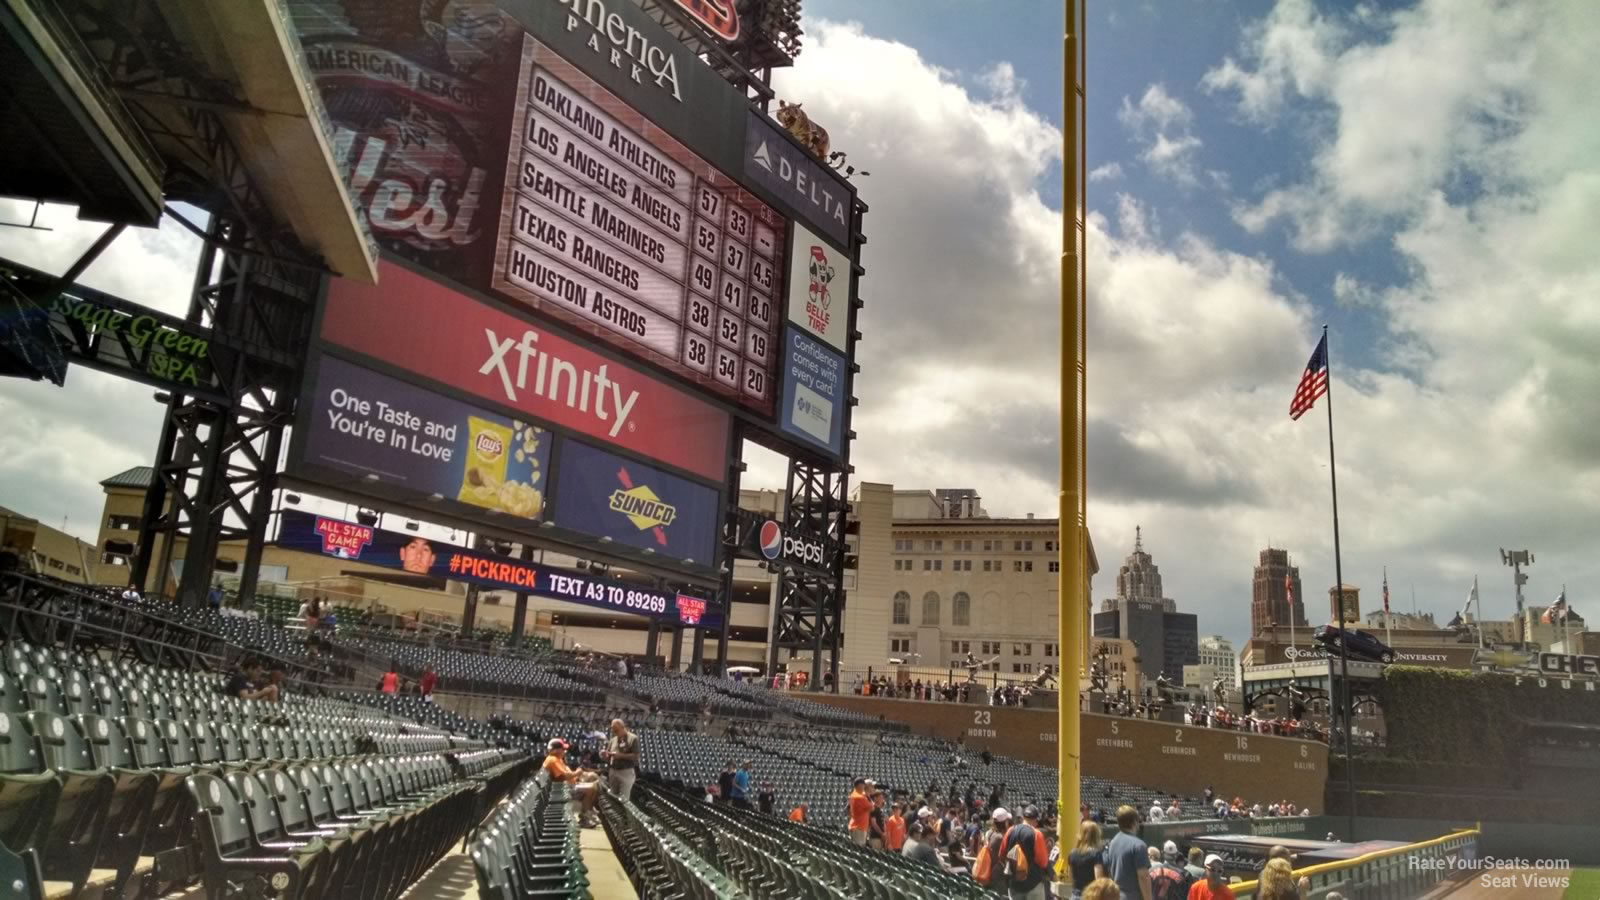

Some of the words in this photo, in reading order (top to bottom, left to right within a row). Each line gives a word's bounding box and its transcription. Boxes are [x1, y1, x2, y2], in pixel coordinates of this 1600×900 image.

[567, 14, 643, 84] PARK
[306, 50, 408, 82] AMERICAN
[418, 71, 487, 112] LEAGUE
[534, 76, 605, 142] OAKLAND
[608, 127, 677, 190] ATHLETICS
[701, 188, 718, 216] 57
[730, 209, 746, 236] 33
[528, 117, 559, 156] LOS
[563, 141, 628, 200] ANGELES
[631, 184, 682, 233] ANGELS
[698, 225, 715, 254] 52
[727, 245, 743, 271] 37
[753, 261, 772, 289] 4.5
[779, 156, 845, 226] DELTA
[522, 161, 587, 219] SEATTLE
[591, 201, 666, 264] MARINERS
[695, 263, 713, 291] 49
[724, 281, 741, 308] 41
[750, 295, 770, 323] 8.0
[518, 204, 567, 253] TEXAS
[571, 234, 640, 292] RANGERS
[691, 300, 710, 328] 38
[721, 317, 738, 345] 52
[751, 333, 766, 358] 19
[511, 250, 588, 309] HOUSTON
[591, 291, 647, 338] ASTROS
[688, 338, 707, 366] 38
[719, 353, 736, 381] 54
[747, 368, 764, 394] 20
[806, 301, 831, 325] BELLE
[807, 314, 827, 335] TIRE
[130, 314, 209, 359] Green
[793, 334, 838, 370] Confidence
[151, 353, 199, 387] SPA
[478, 327, 640, 438] xfinity
[791, 365, 815, 388] every
[792, 351, 819, 374] comes
[820, 366, 838, 384] with
[330, 388, 371, 416] One
[375, 401, 421, 431] Taste
[424, 421, 458, 443] and
[327, 409, 386, 444] You're
[390, 429, 407, 450] In
[410, 434, 453, 463] Love
[611, 491, 675, 524] SUNOCO
[319, 520, 340, 534] ALL
[343, 525, 371, 540] STAR
[327, 532, 359, 549] GAME
[783, 535, 825, 564] pepsi
[449, 553, 537, 588] #PICKRICK
[549, 573, 584, 597] TEXT
[585, 582, 604, 601] A3
[607, 586, 624, 605] TO
[626, 590, 666, 614] 89269
[678, 598, 689, 607] ALL
[690, 599, 705, 609] STAR
[682, 605, 699, 617] GAME
[967, 728, 997, 738] HORTON
[973, 710, 991, 725] 23
[1111, 721, 1119, 735] 5
[1096, 738, 1134, 749] GREENBERG
[1175, 729, 1183, 743] 2
[1236, 736, 1248, 750] 16
[1300, 744, 1308, 757] 6
